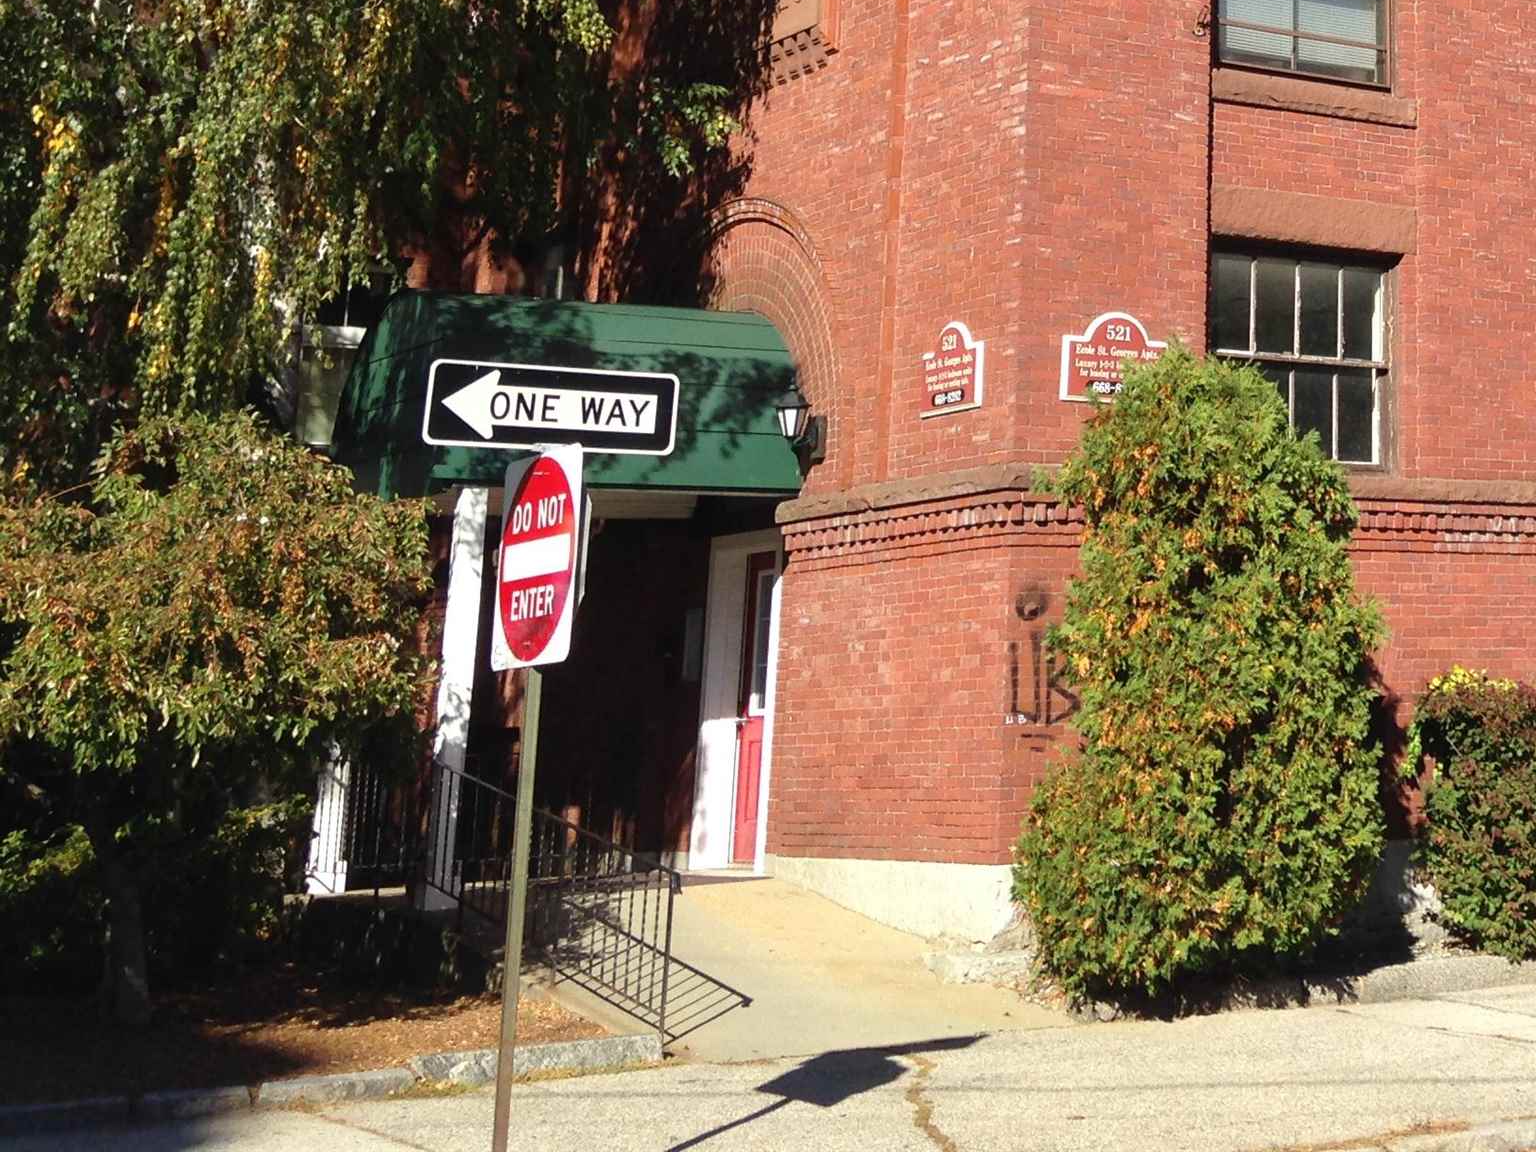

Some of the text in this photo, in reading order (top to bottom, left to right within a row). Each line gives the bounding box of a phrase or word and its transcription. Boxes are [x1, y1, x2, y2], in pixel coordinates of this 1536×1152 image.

[1106, 324, 1131, 342] 521
[490, 392, 650, 427] ONE WAY
[512, 493, 567, 535] DO NOT
[510, 584, 554, 622] ENTER
